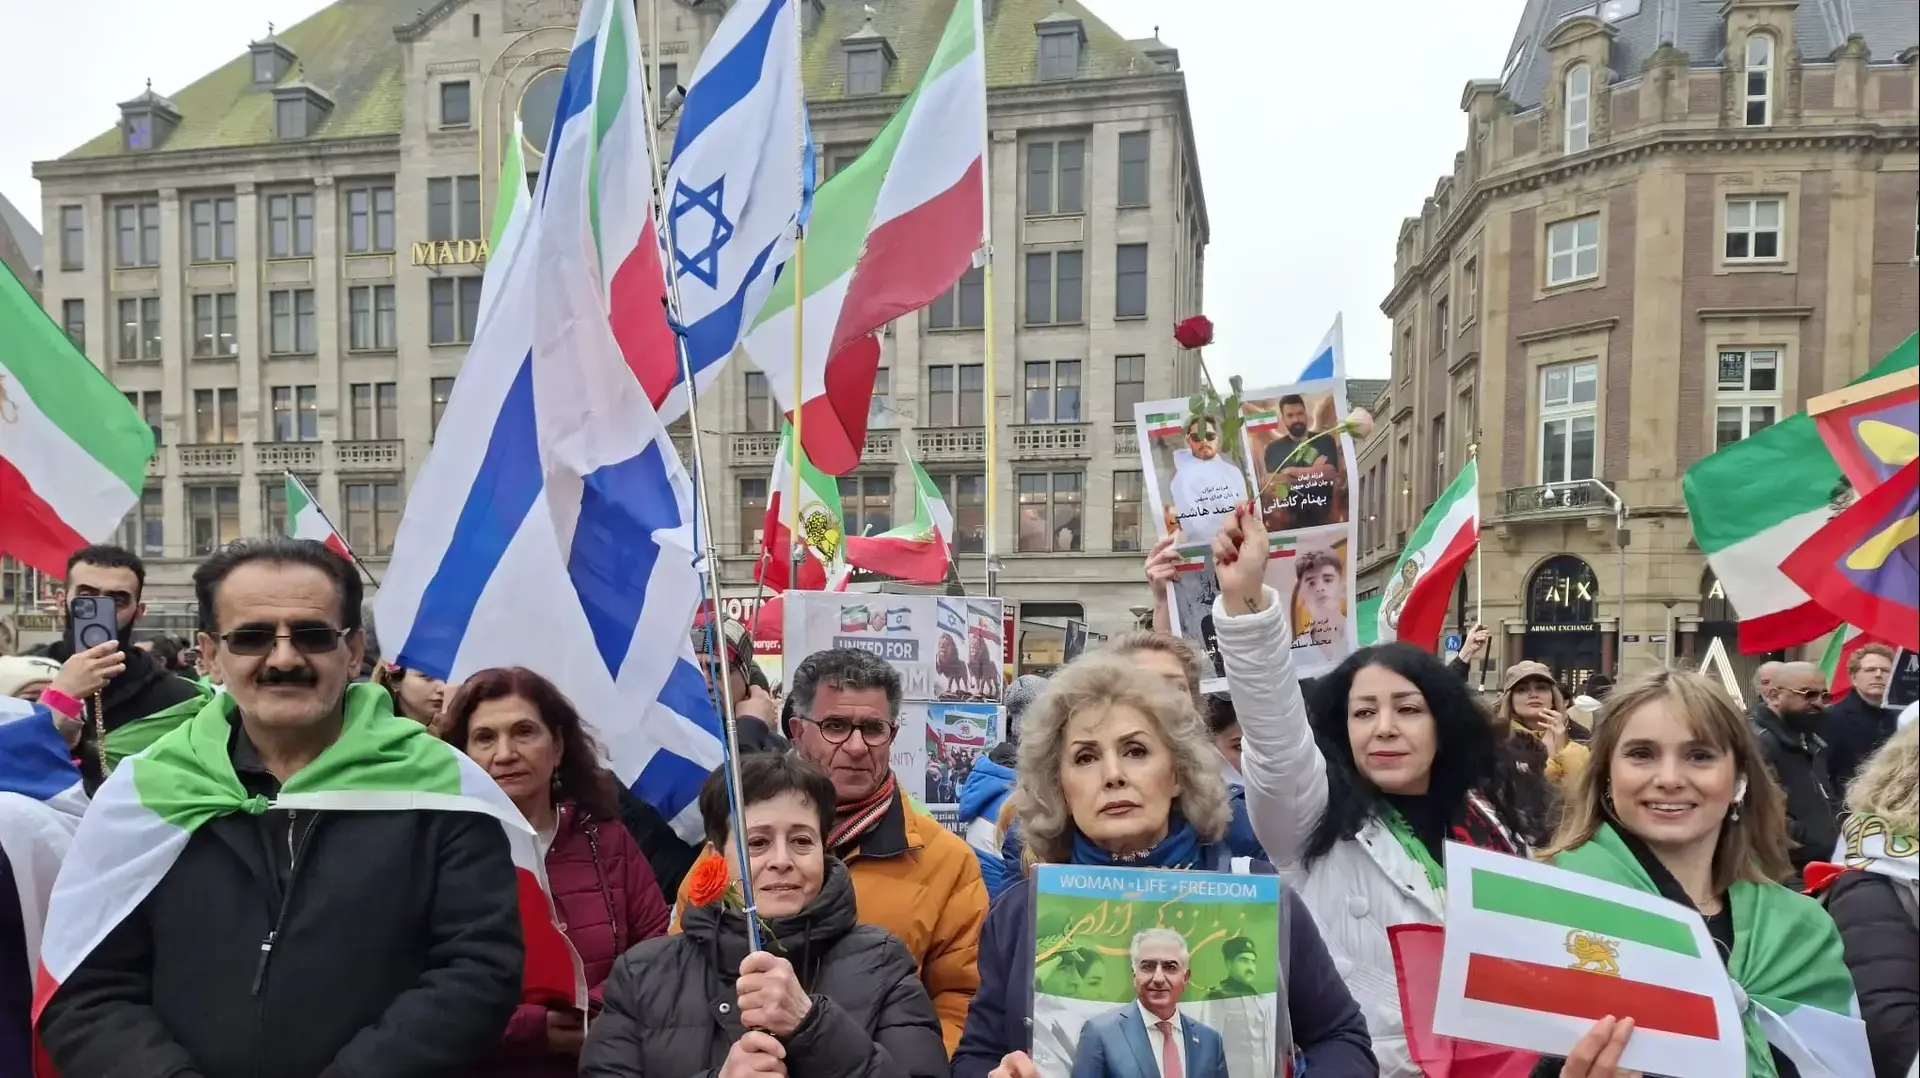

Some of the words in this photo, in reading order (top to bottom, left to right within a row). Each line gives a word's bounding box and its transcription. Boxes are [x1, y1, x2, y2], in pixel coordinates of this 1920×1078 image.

[1263, 495, 1298, 514] کاشانی
[1301, 493, 1327, 509] بهنام
[1213, 505, 1235, 514] حمد
[886, 642, 912, 658] FOR
[1290, 640, 1308, 649] سلط
[1060, 875, 1124, 891] WOMAN
[1136, 880, 1167, 893] LIFE
[1179, 880, 1257, 898] FREEDOM
